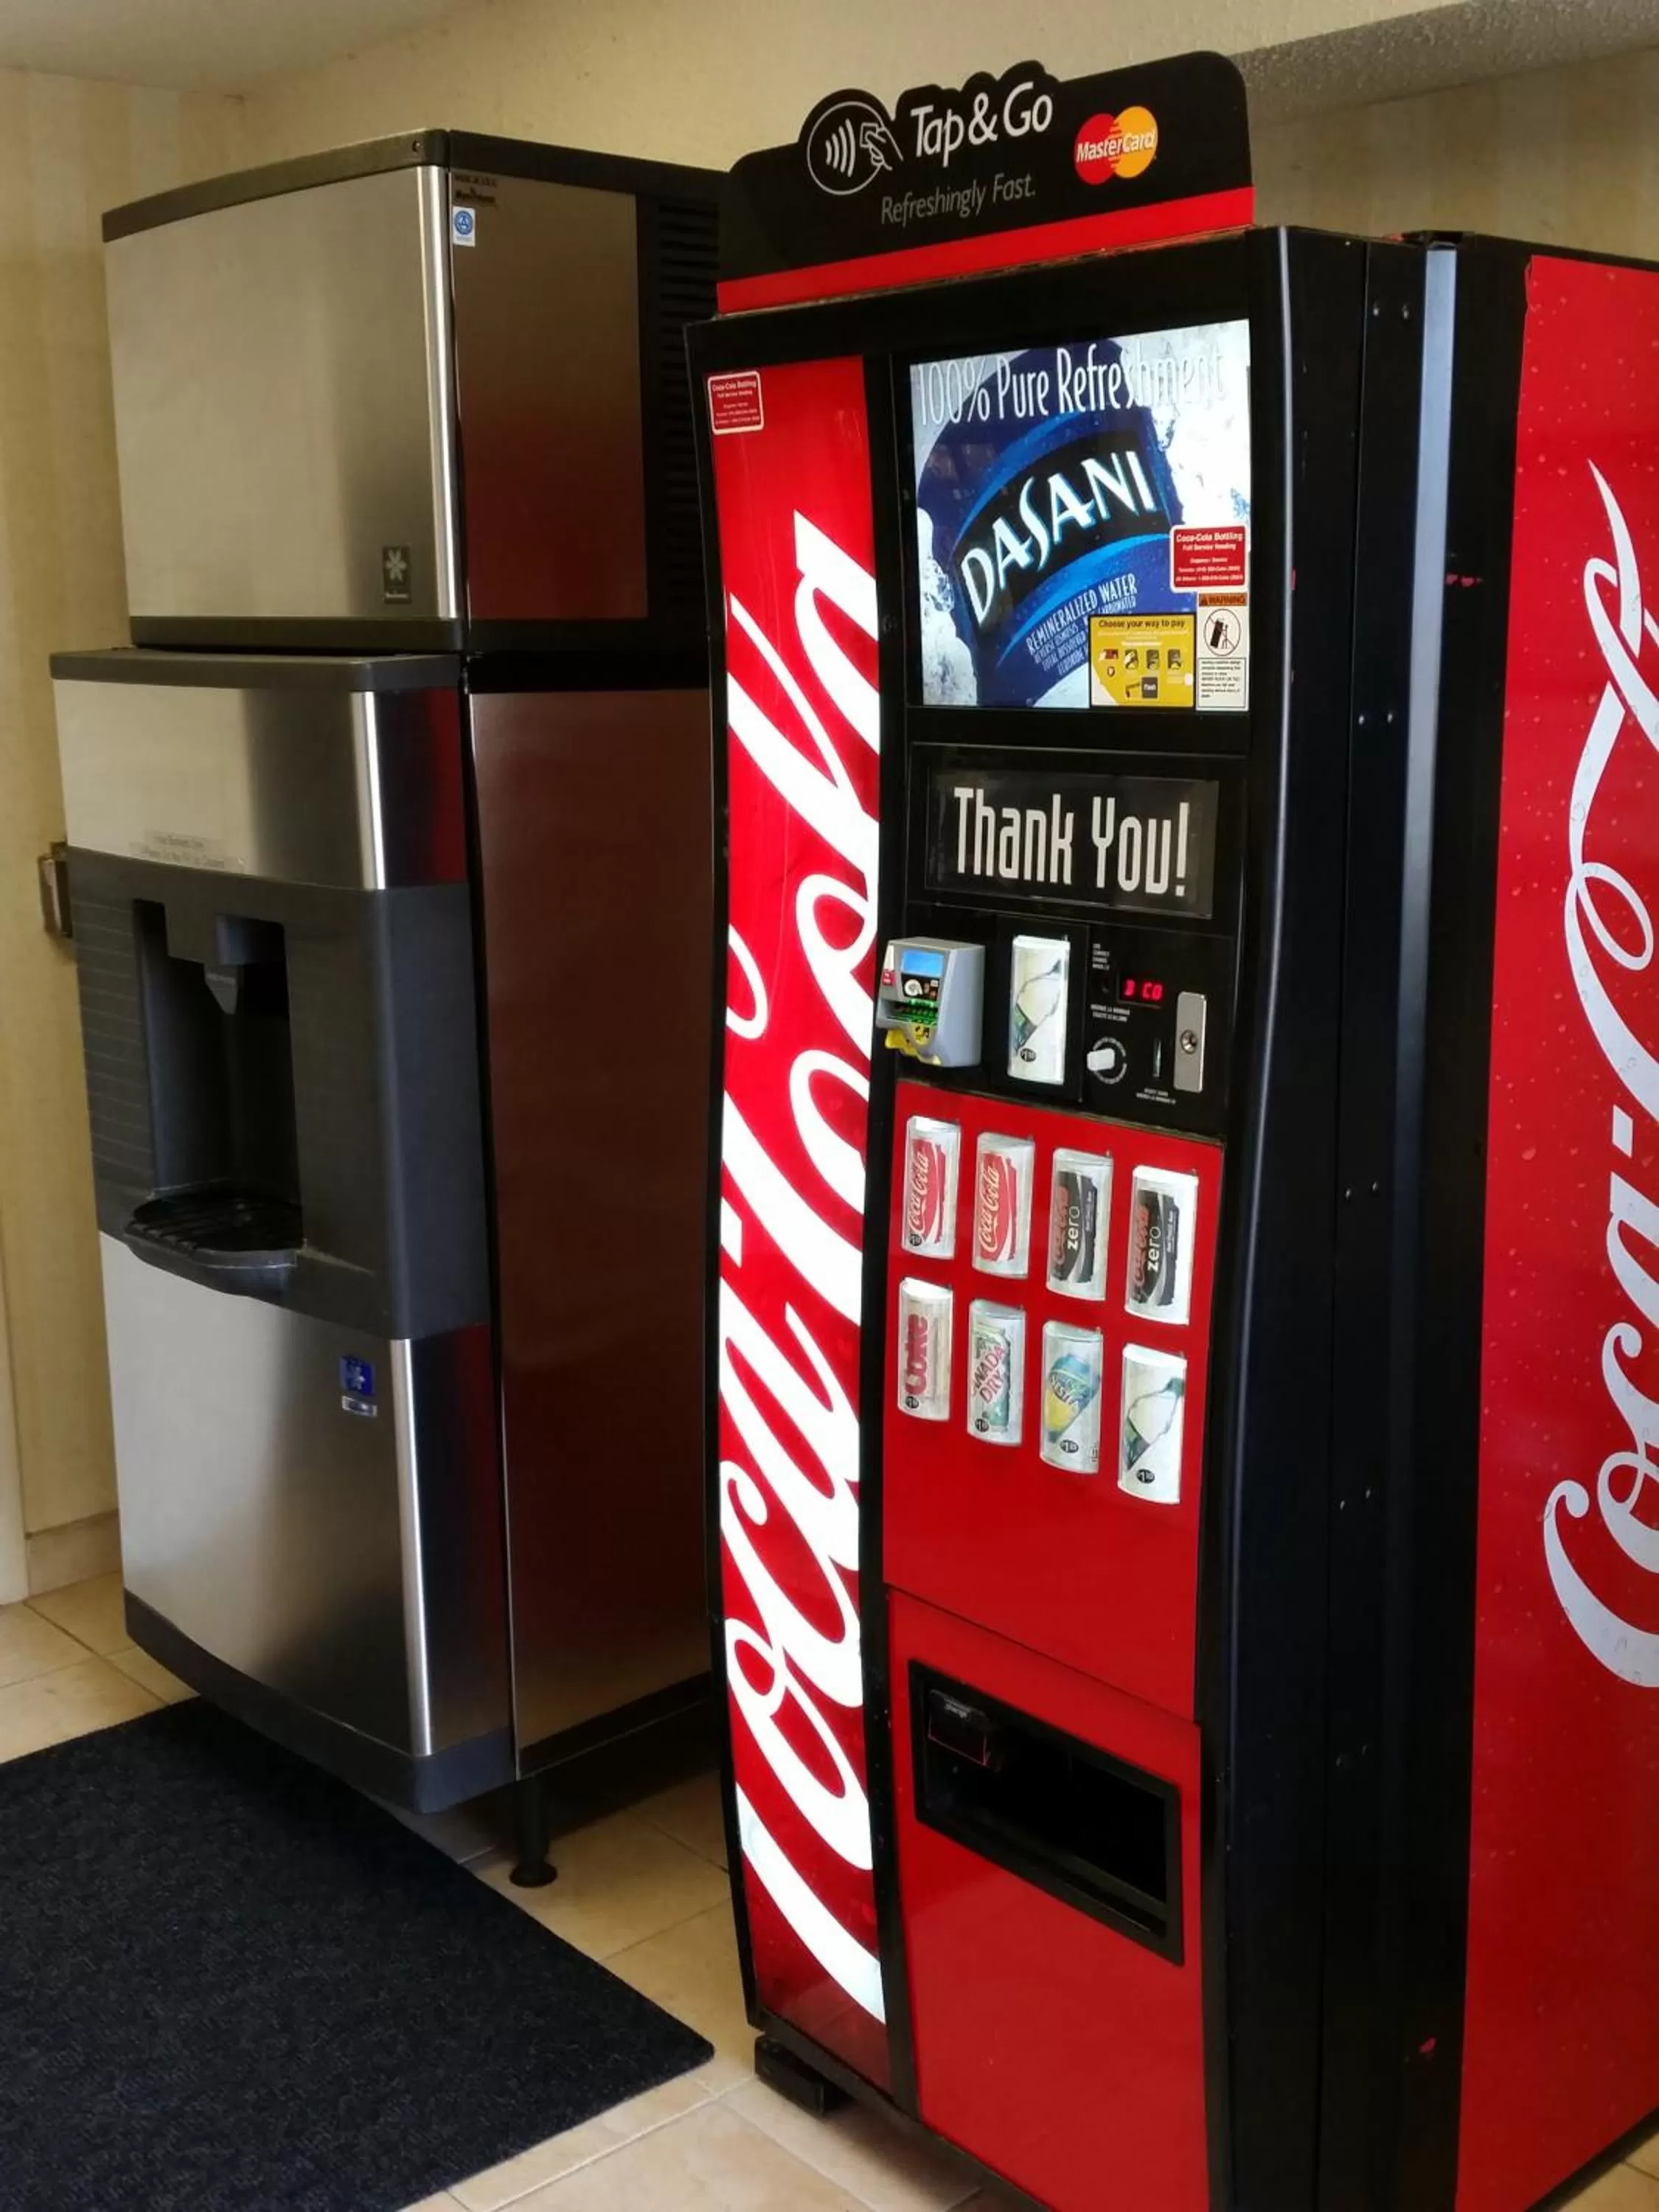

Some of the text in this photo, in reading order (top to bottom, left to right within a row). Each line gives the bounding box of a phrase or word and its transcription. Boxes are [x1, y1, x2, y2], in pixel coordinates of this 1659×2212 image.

[1076, 128, 1156, 163] MasterCard
[881, 173, 1035, 228] Refreshingly Fast.
[919, 338, 1226, 425] 100% Pure Refreshment
[961, 451, 1156, 626] DASANI
[1026, 573, 1137, 655] REMINERALIZED WATER
[953, 787, 1190, 897] Thank You!
[1067, 1206, 1080, 1251] zero
[1147, 1226, 1161, 1273] zero
